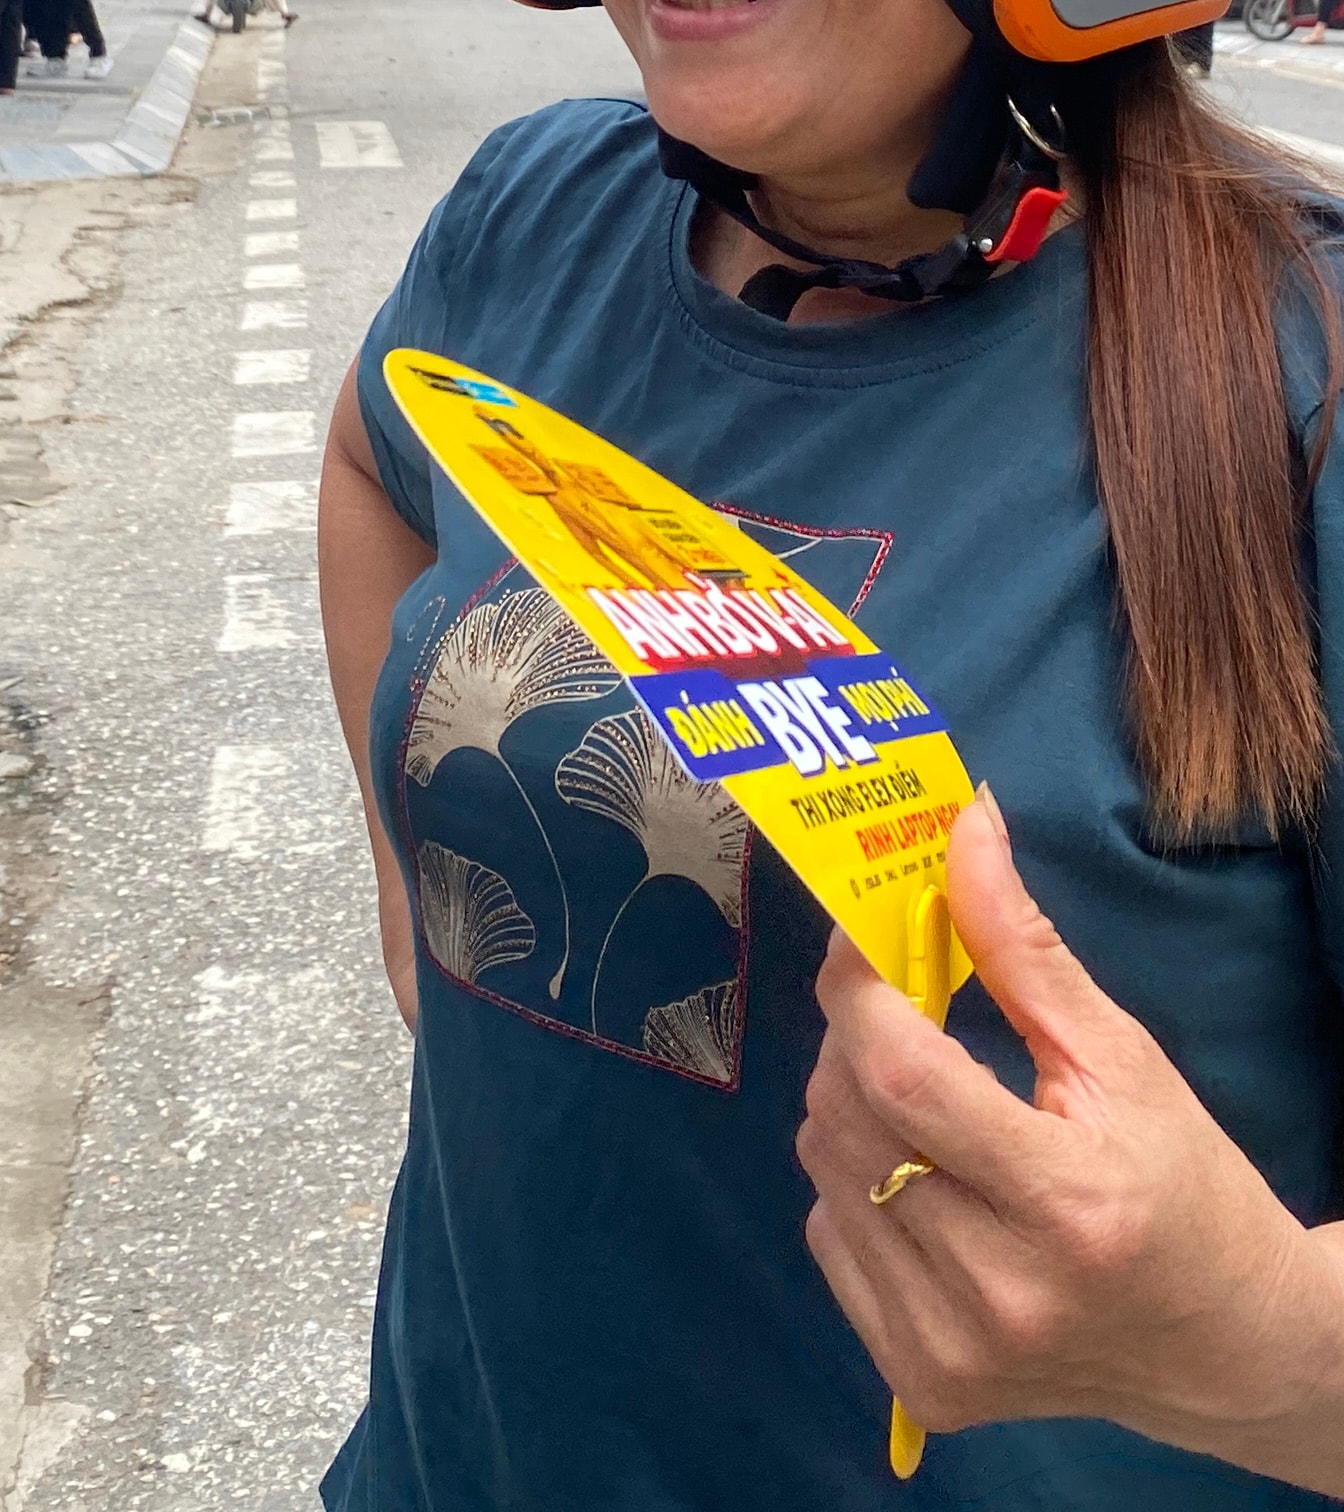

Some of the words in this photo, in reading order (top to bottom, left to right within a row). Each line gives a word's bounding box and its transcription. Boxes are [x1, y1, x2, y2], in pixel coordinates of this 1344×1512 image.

[587, 587, 729, 660] ANH
[664, 689, 766, 759] ĐÁNH
[735, 675, 878, 776] BYE
[837, 679, 901, 733] MỌI
[790, 790, 828, 831] THI
[815, 782, 866, 823] XONG
[856, 774, 899, 812] FLEX
[856, 821, 898, 862] RINH
[889, 809, 939, 851] LAPTOP
